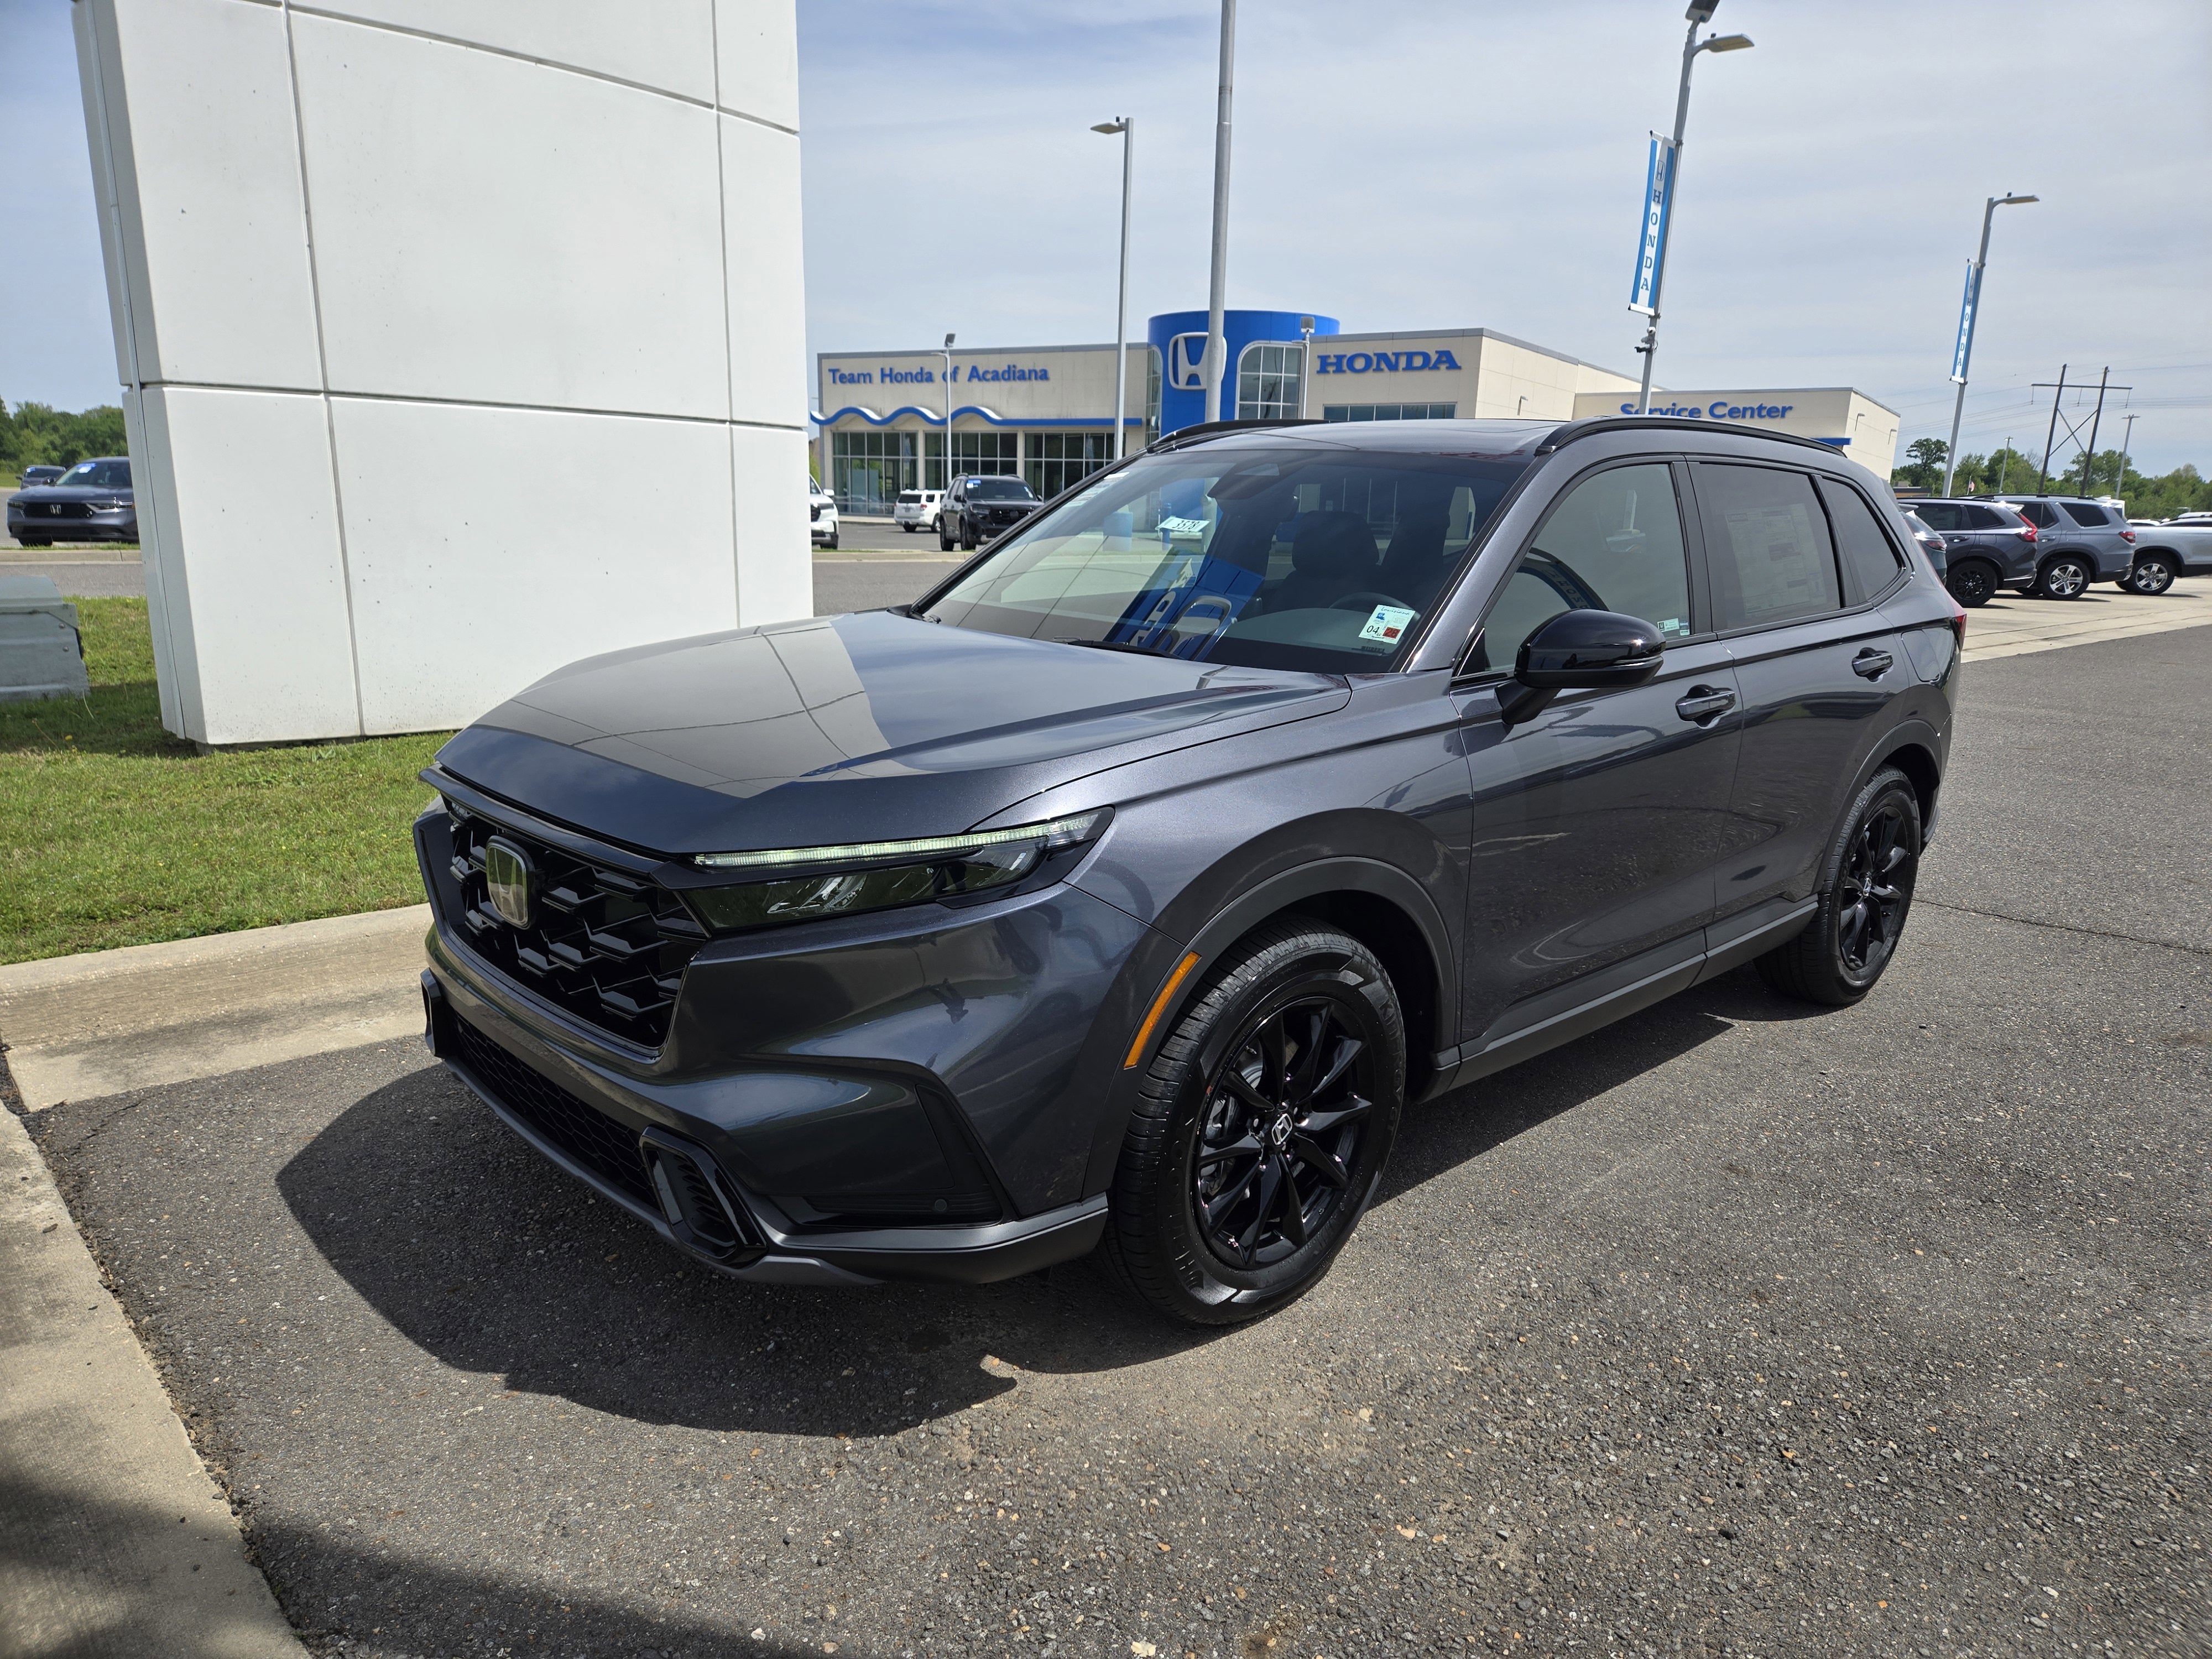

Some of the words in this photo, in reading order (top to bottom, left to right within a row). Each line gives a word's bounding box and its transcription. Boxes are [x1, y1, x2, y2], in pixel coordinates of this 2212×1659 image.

[1640, 189, 1662, 291] HONDA
[1957, 298, 1972, 367] HONDA
[1316, 349, 1462, 374] HONDA
[828, 368, 873, 384] Team
[880, 366, 935, 384] Honda
[942, 365, 959, 383] of
[967, 364, 1050, 382] Acadiana
[1708, 401, 1793, 419] Center
[1366, 625, 1380, 634] 04
